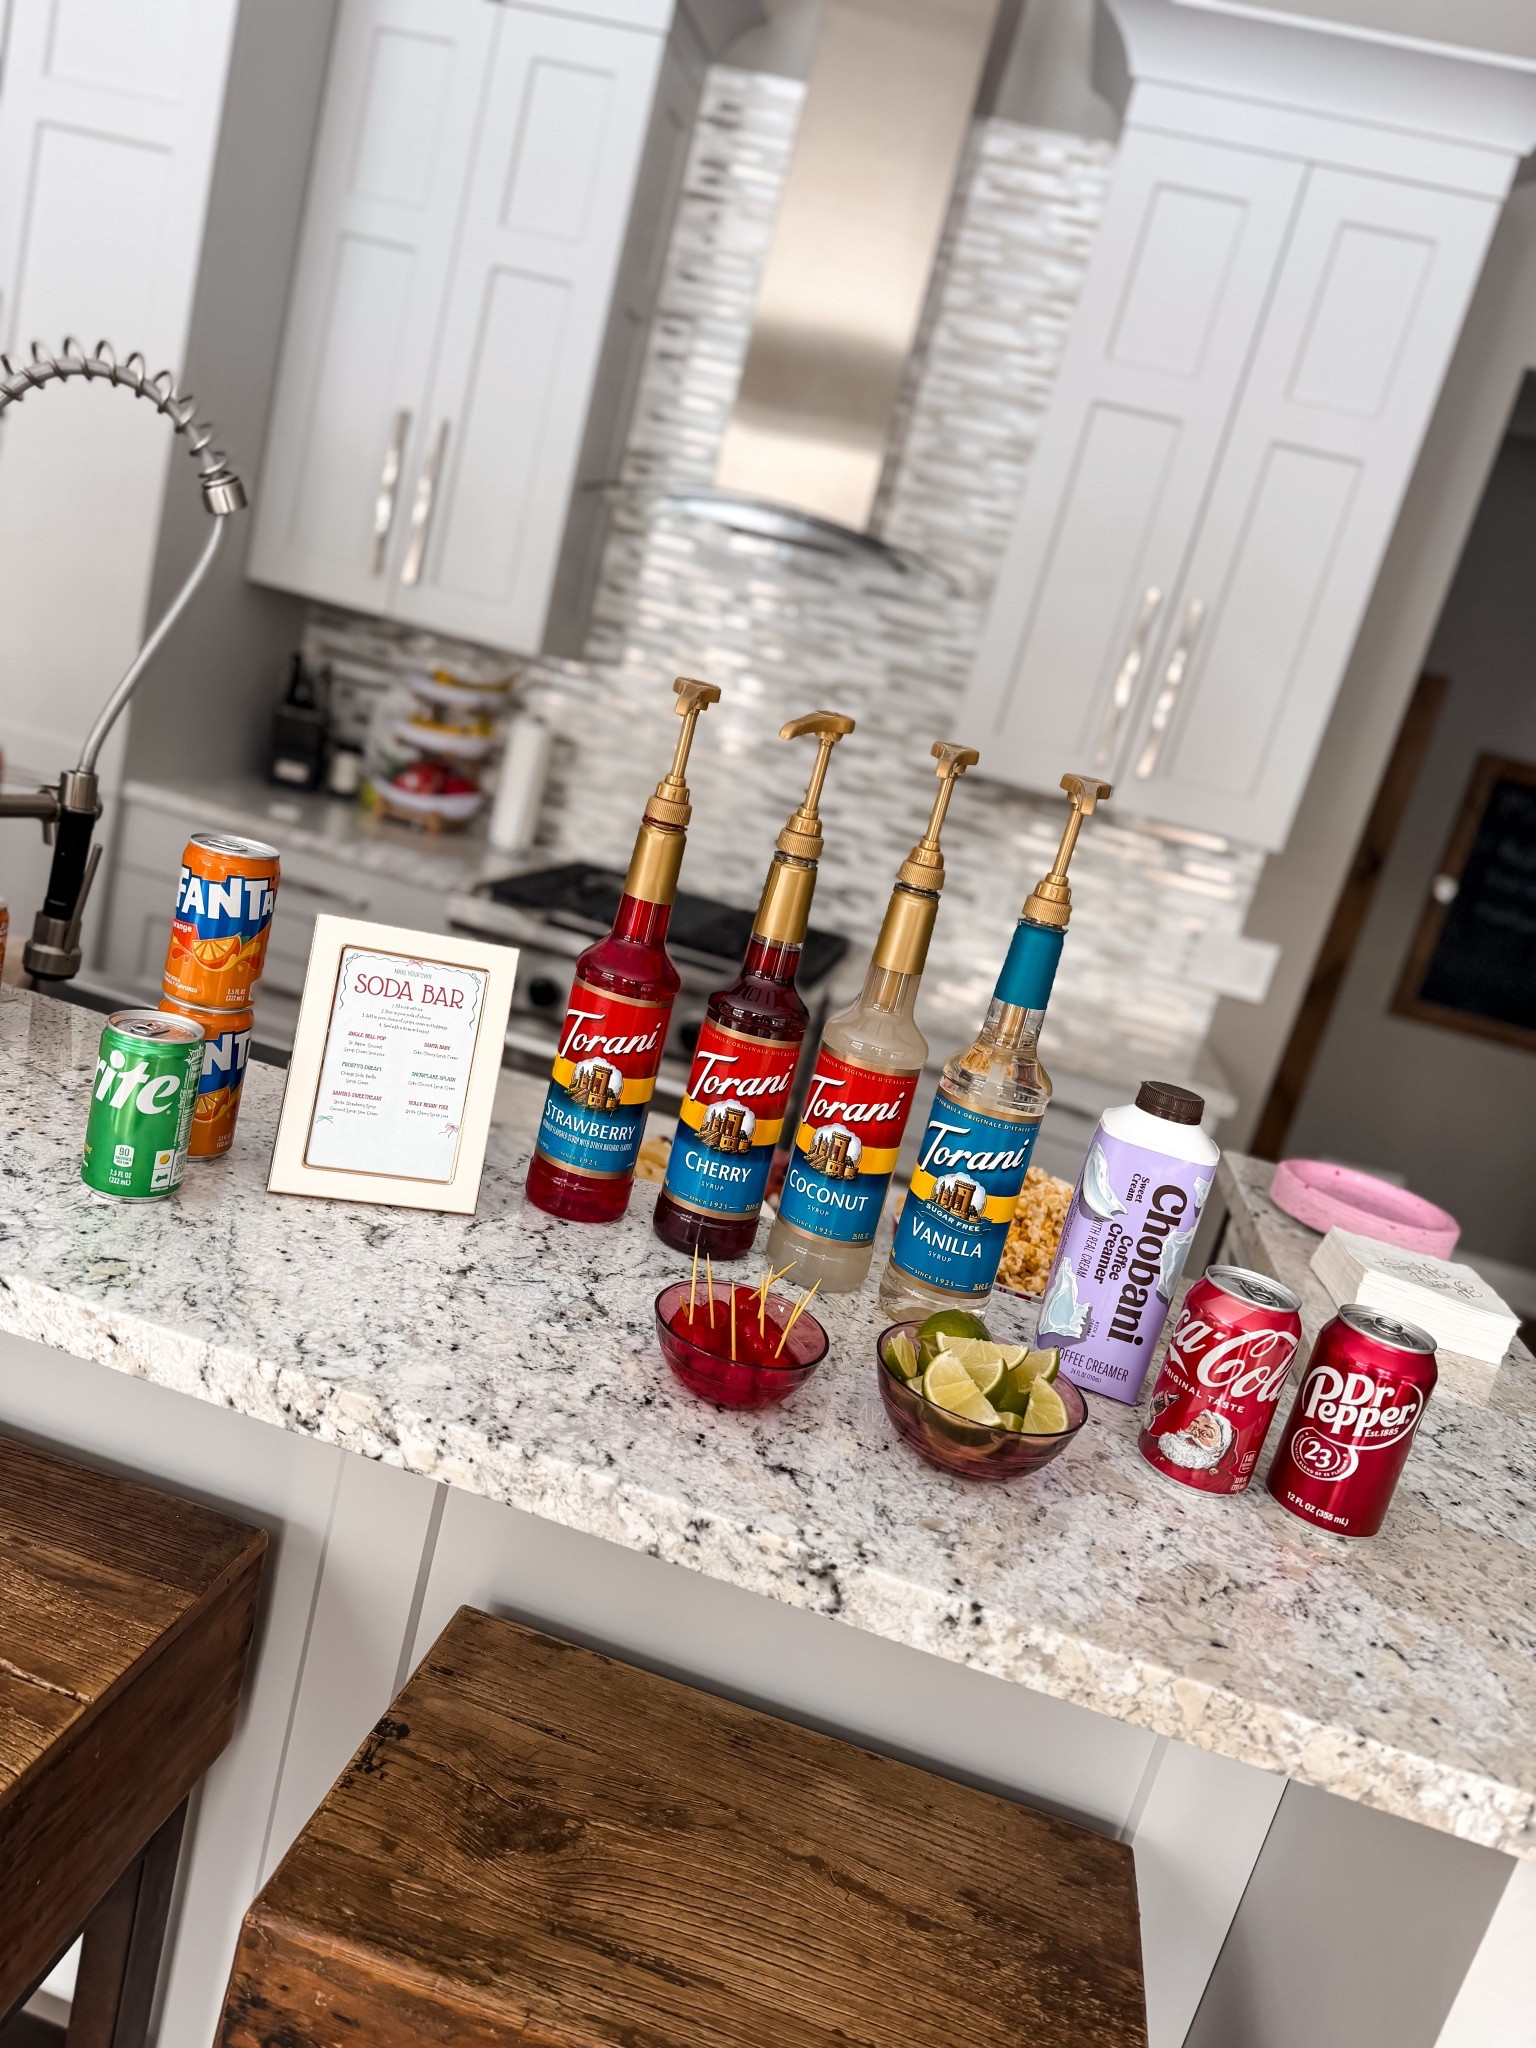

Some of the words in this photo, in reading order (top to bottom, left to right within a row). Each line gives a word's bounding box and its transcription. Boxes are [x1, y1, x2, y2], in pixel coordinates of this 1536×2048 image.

[176, 867, 273, 920] FANTA
[354, 974, 413, 1001] SODA
[421, 984, 464, 1009] BAR
[559, 1008, 662, 1059] Torani
[732, 1041, 769, 1054] ORIGINALE
[95, 1050, 181, 1114] rite
[689, 1050, 794, 1101] Torani
[840, 1065, 876, 1080] ORIGINALE
[803, 1073, 906, 1125] Torani
[938, 1099, 961, 1115] FORMULA
[963, 1113, 1002, 1128] ORIGINALE
[545, 1099, 636, 1140] STRAWBERRY
[119, 1147, 130, 1157] 90
[919, 1120, 1030, 1172] Torani
[109, 1176, 120, 1184] (222
[685, 1151, 752, 1183] CHERRY
[701, 1181, 724, 1191] SYRUP
[790, 1169, 869, 1212] COCONUT
[1126, 1173, 1141, 1201] Cream
[1135, 1177, 1150, 1203] Sweet
[689, 1195, 707, 1205] SINCE
[710, 1201, 728, 1210] 1925
[807, 1204, 830, 1217] SYRUP
[926, 1203, 955, 1224] SUGAR
[956, 1222, 980, 1232] FREE
[796, 1218, 812, 1229] SINCE
[814, 1225, 833, 1235] 1925
[912, 1216, 982, 1258] VANILLA
[1090, 1216, 1105, 1235] WITH
[927, 1250, 952, 1263] SYRUP
[1084, 1235, 1099, 1255] REAL
[1094, 1223, 1123, 1284] Creamer
[1108, 1235, 1133, 1281] Coffee
[914, 1269, 932, 1280] SINCE
[935, 1276, 954, 1287] 1925
[1076, 1253, 1093, 1278] CREAM
[1108, 1184, 1188, 1346] Chobani
[1054, 1345, 1085, 1368] OFFEE
[1086, 1358, 1129, 1382] CREAMER
[1173, 1308, 1299, 1403] ca-Col
[1164, 1364, 1202, 1399] ORIGINAL
[1207, 1395, 1245, 1414] TASTE
[1302, 1366, 1417, 1437] Pepper
[1339, 1372, 1396, 1408] Dr
[1299, 1460, 1314, 1474] BLEND
[1304, 1441, 1332, 1468] 23
[1287, 1491, 1295, 1502] 12
[1295, 1497, 1304, 1508] FL
[1304, 1502, 1316, 1513] OZ
[1316, 1509, 1333, 1521] (355
[1334, 1516, 1349, 1527] mL)
